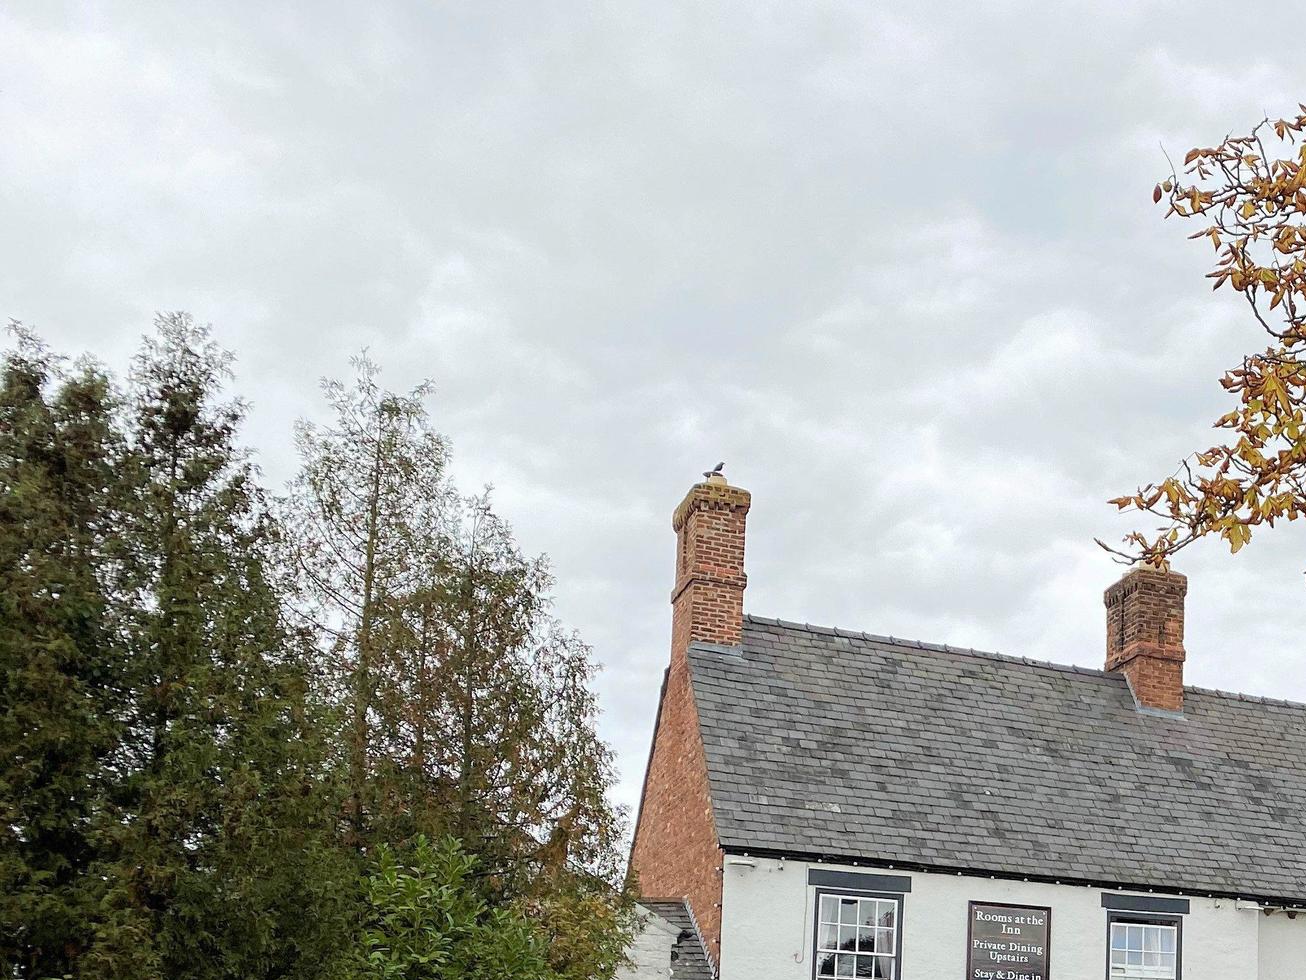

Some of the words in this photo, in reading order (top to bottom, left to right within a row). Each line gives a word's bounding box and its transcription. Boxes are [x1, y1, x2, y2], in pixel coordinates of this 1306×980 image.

[976, 910, 1012, 922] Rooms
[1015, 916, 1025, 924] at
[1026, 916, 1044, 926] the
[1001, 924, 1020, 935] Inn
[974, 940, 1006, 950] Private
[1009, 942, 1043, 956] Dining
[990, 952, 1028, 963] Upstairs
[974, 968, 995, 980] Stay
[996, 971, 1006, 980] &
[1007, 971, 1030, 980] Dine
